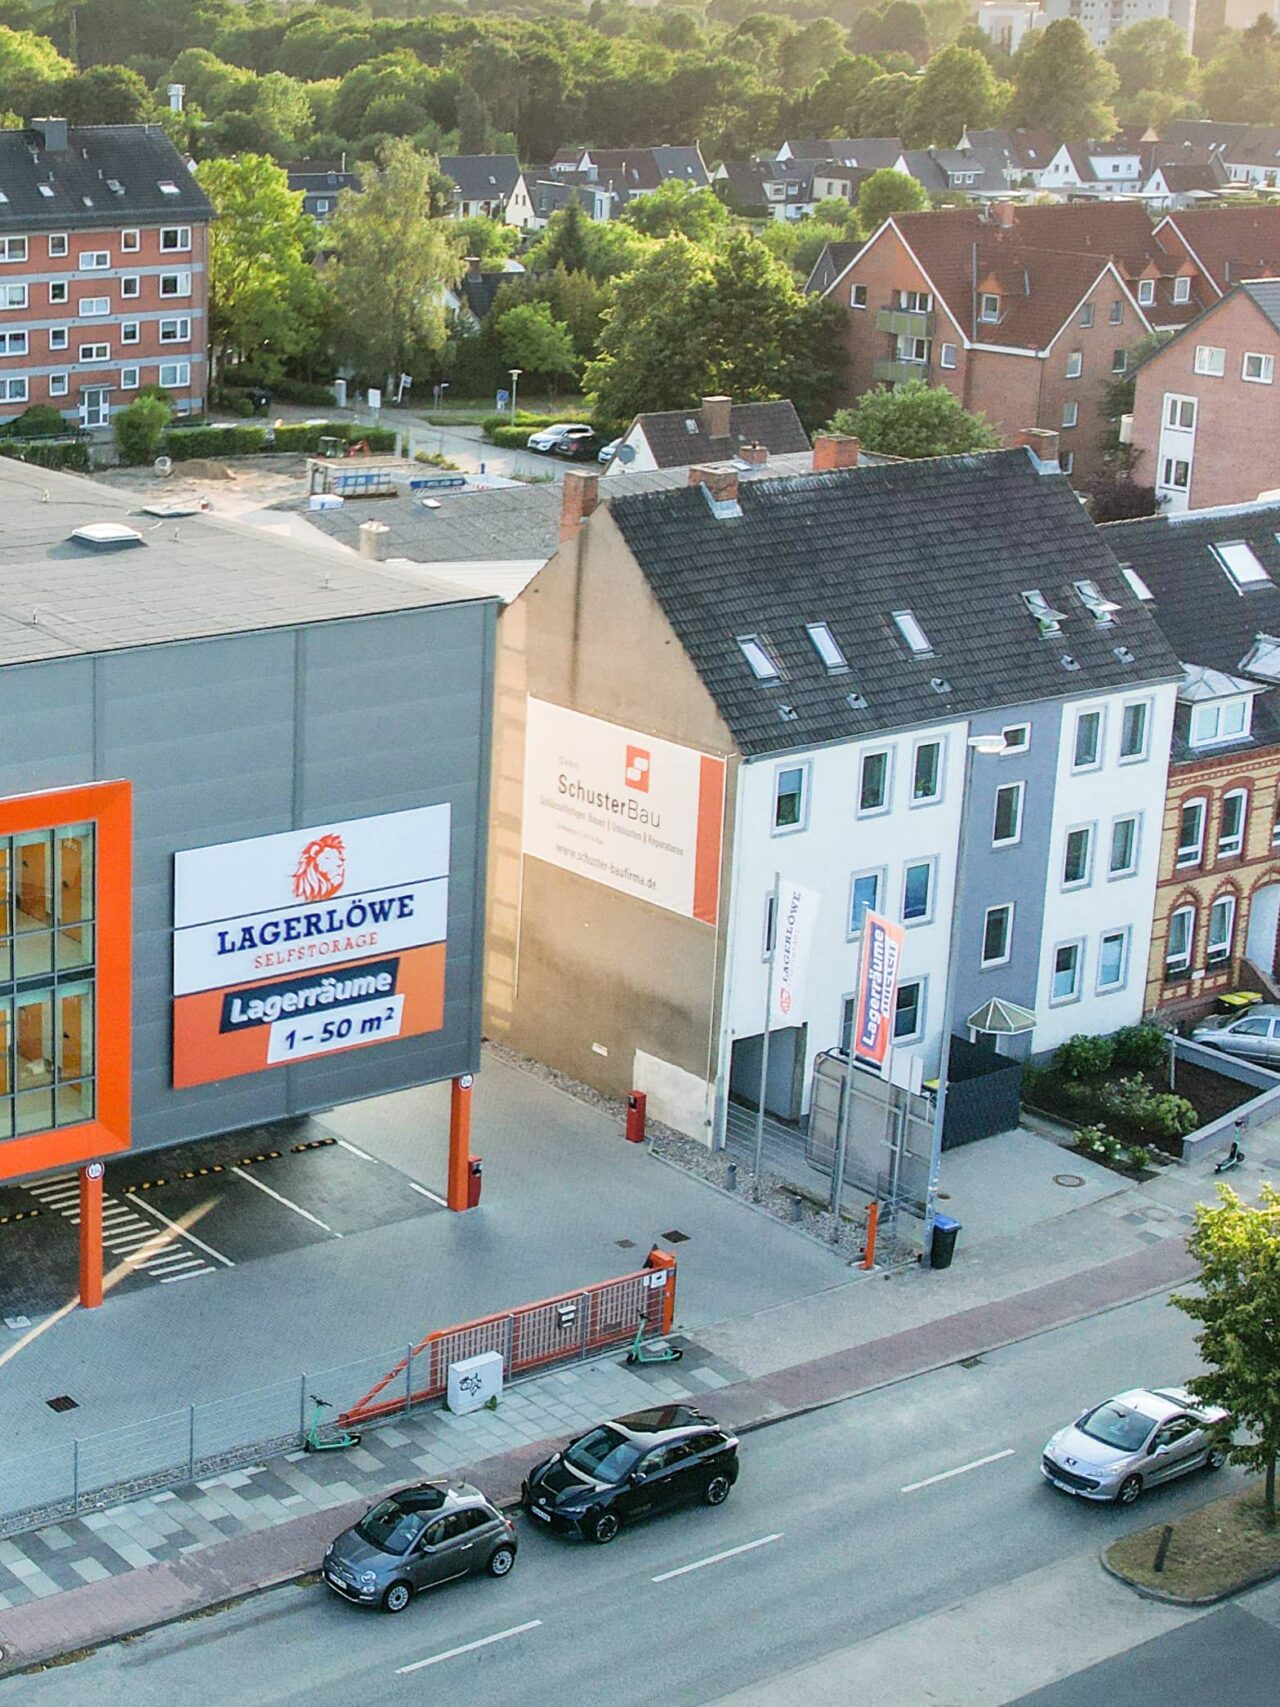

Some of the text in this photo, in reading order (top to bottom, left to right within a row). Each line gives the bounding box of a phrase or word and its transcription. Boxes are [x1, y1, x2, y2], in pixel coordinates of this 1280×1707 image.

[558, 774, 662, 828] SchusterBau
[217, 894, 415, 955] LAGERLÖWE
[254, 932, 378, 969] SELFSTORAGE
[229, 971, 394, 1024] Lagerräume
[862, 928, 885, 1047] Lagerräume
